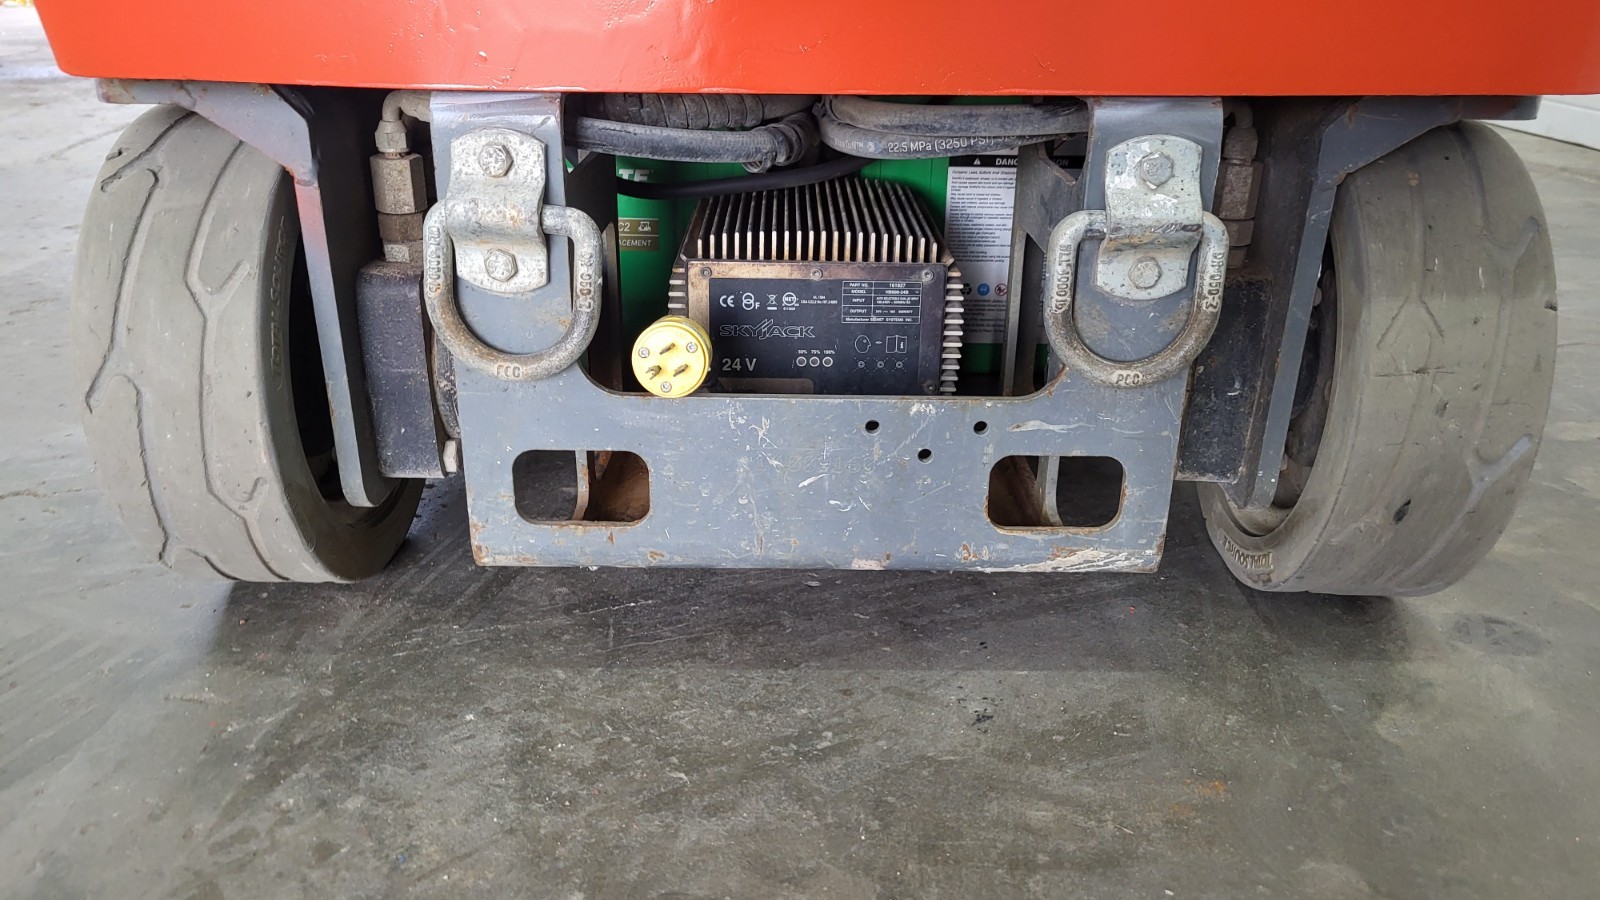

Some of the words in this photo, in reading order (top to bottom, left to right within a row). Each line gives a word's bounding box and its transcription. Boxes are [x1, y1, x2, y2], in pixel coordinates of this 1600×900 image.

[888, 141, 908, 153] 22.5
[910, 140, 932, 152] MPa
[934, 136, 968, 153] (3250
[619, 239, 652, 247] CEMENT
[720, 319, 816, 341] SKYJACK
[722, 358, 741, 371] 24
[745, 358, 757, 371] V
